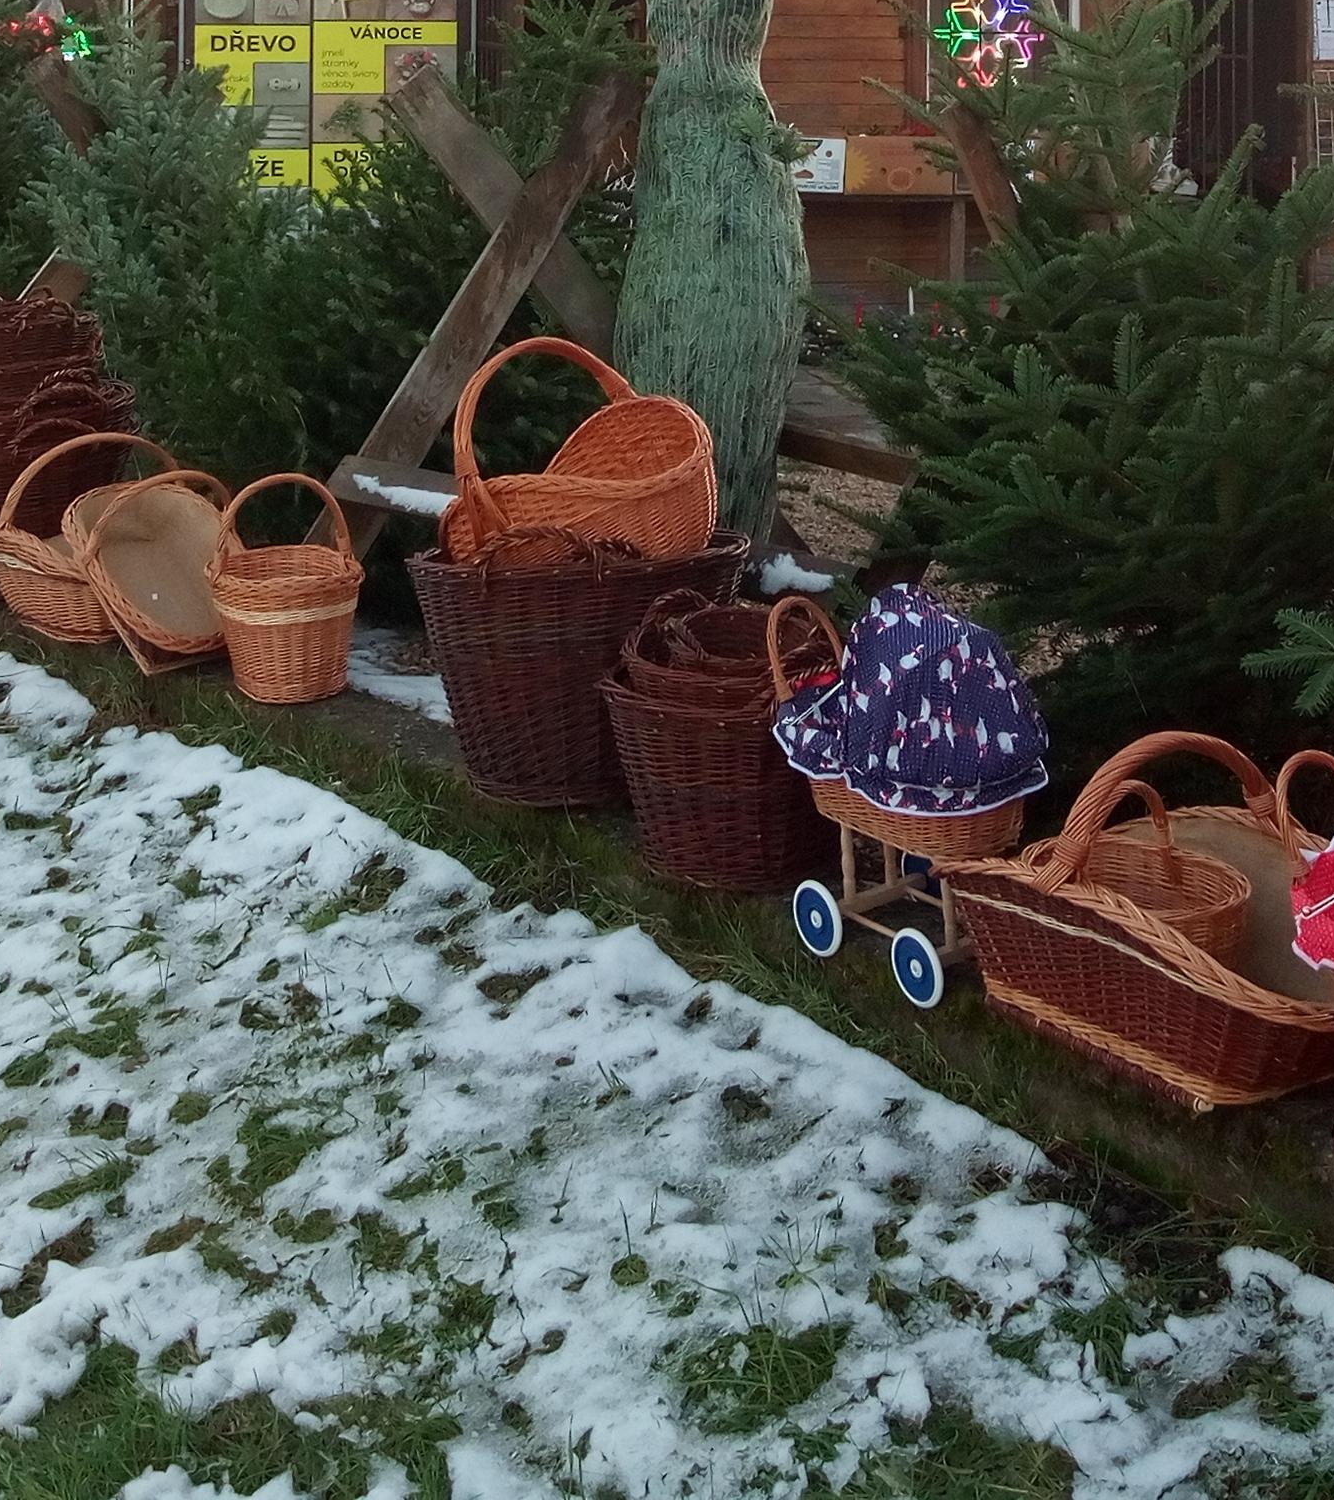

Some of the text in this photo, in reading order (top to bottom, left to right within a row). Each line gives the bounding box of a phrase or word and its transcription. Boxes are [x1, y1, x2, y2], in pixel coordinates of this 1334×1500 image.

[210, 30, 296, 52] DŘEVO
[349, 24, 423, 40] VÁNOCE
[255, 155, 284, 177] ŽE
